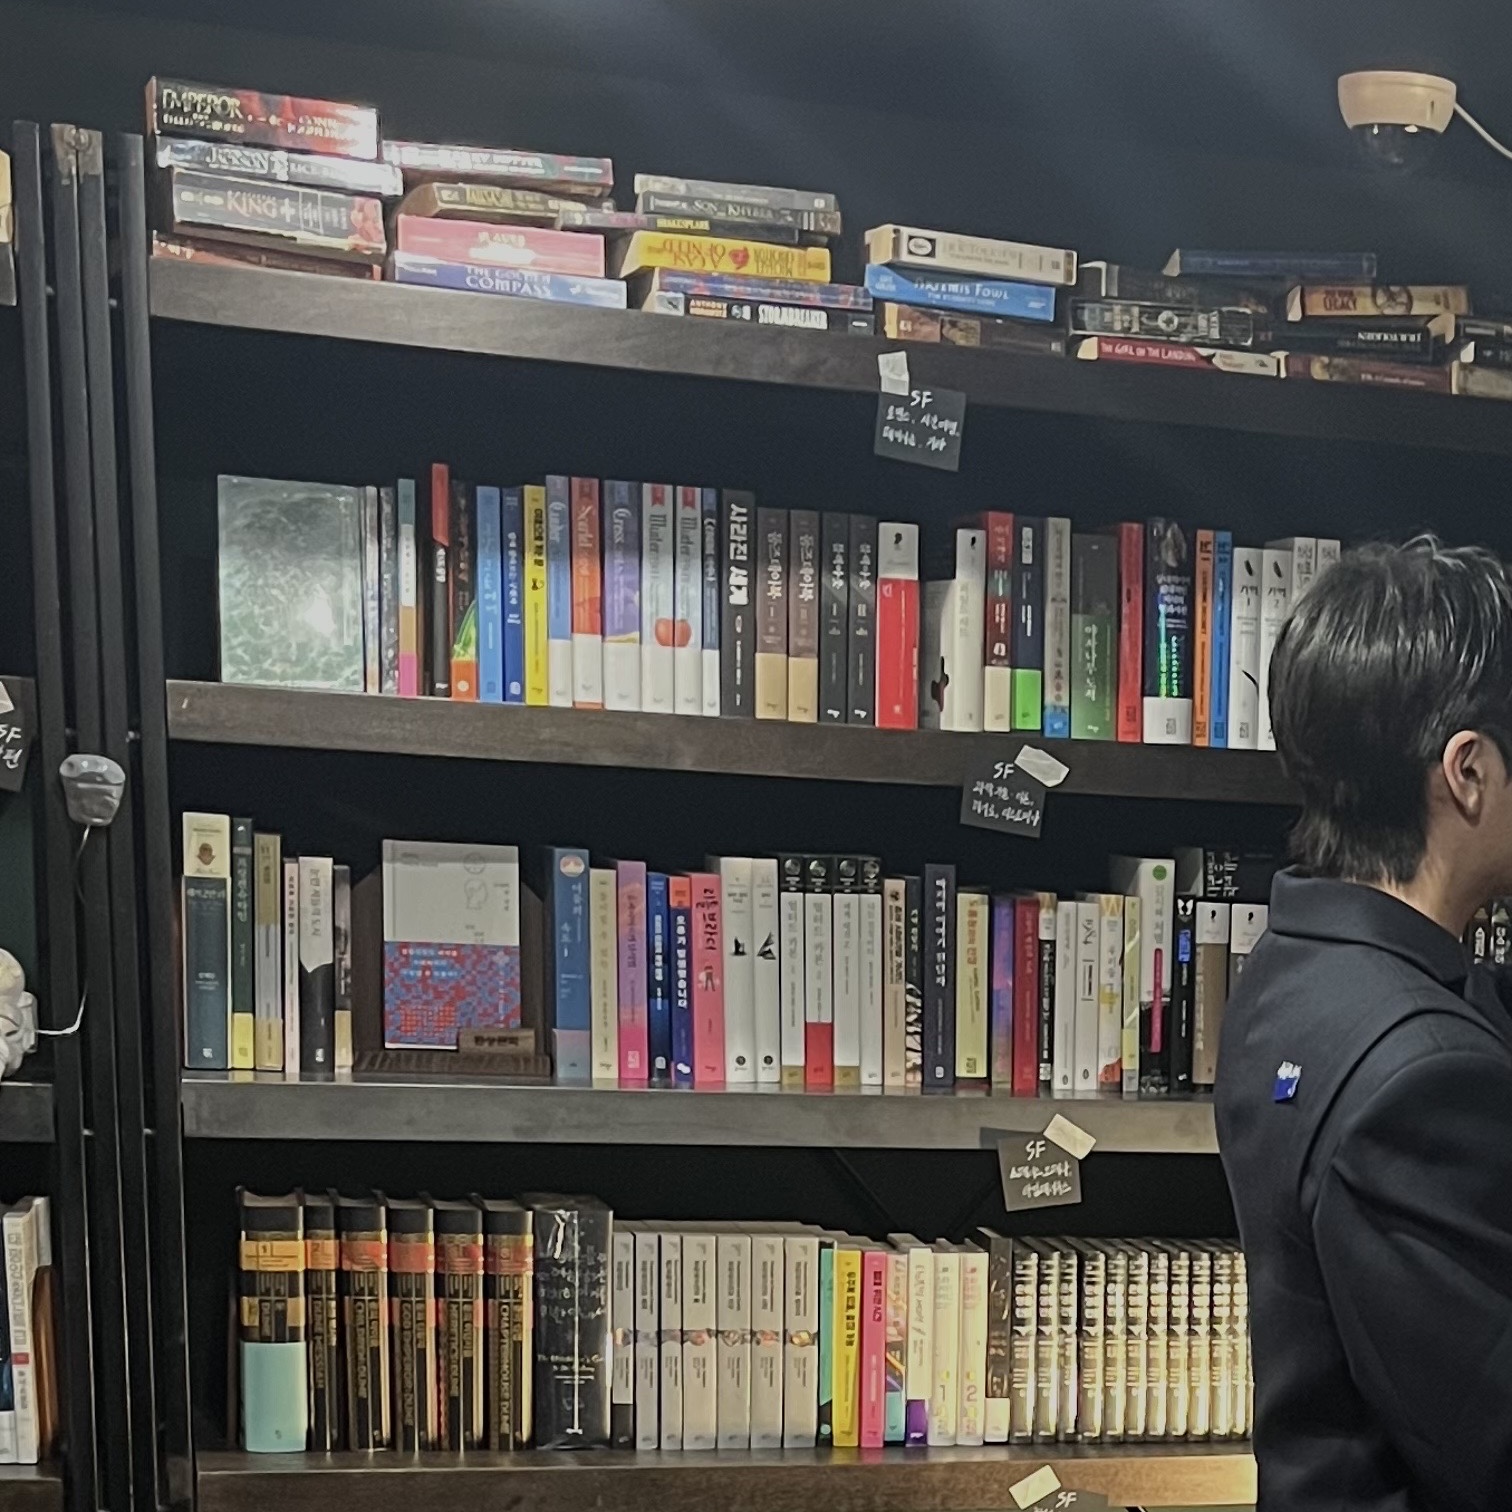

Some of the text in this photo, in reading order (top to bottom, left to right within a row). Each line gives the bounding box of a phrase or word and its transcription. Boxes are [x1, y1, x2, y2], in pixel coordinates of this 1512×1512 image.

[464, 275, 554, 299] COMPASS
[910, 390, 933, 408] SF
[729, 503, 748, 605] 사라진 세계
[993, 762, 1014, 779] SF
[696, 888, 719, 951] 리틀 브라더
[1025, 1140, 1046, 1160] SF
[261, 1302, 271, 1337] DUNE
[314, 1336, 325, 1389] MESSIAH
[357, 1361, 368, 1399] DUNE
[501, 1304, 511, 1434] CHAPTERHOUSE DUNE
[1055, 1491, 1077, 1508] SF
